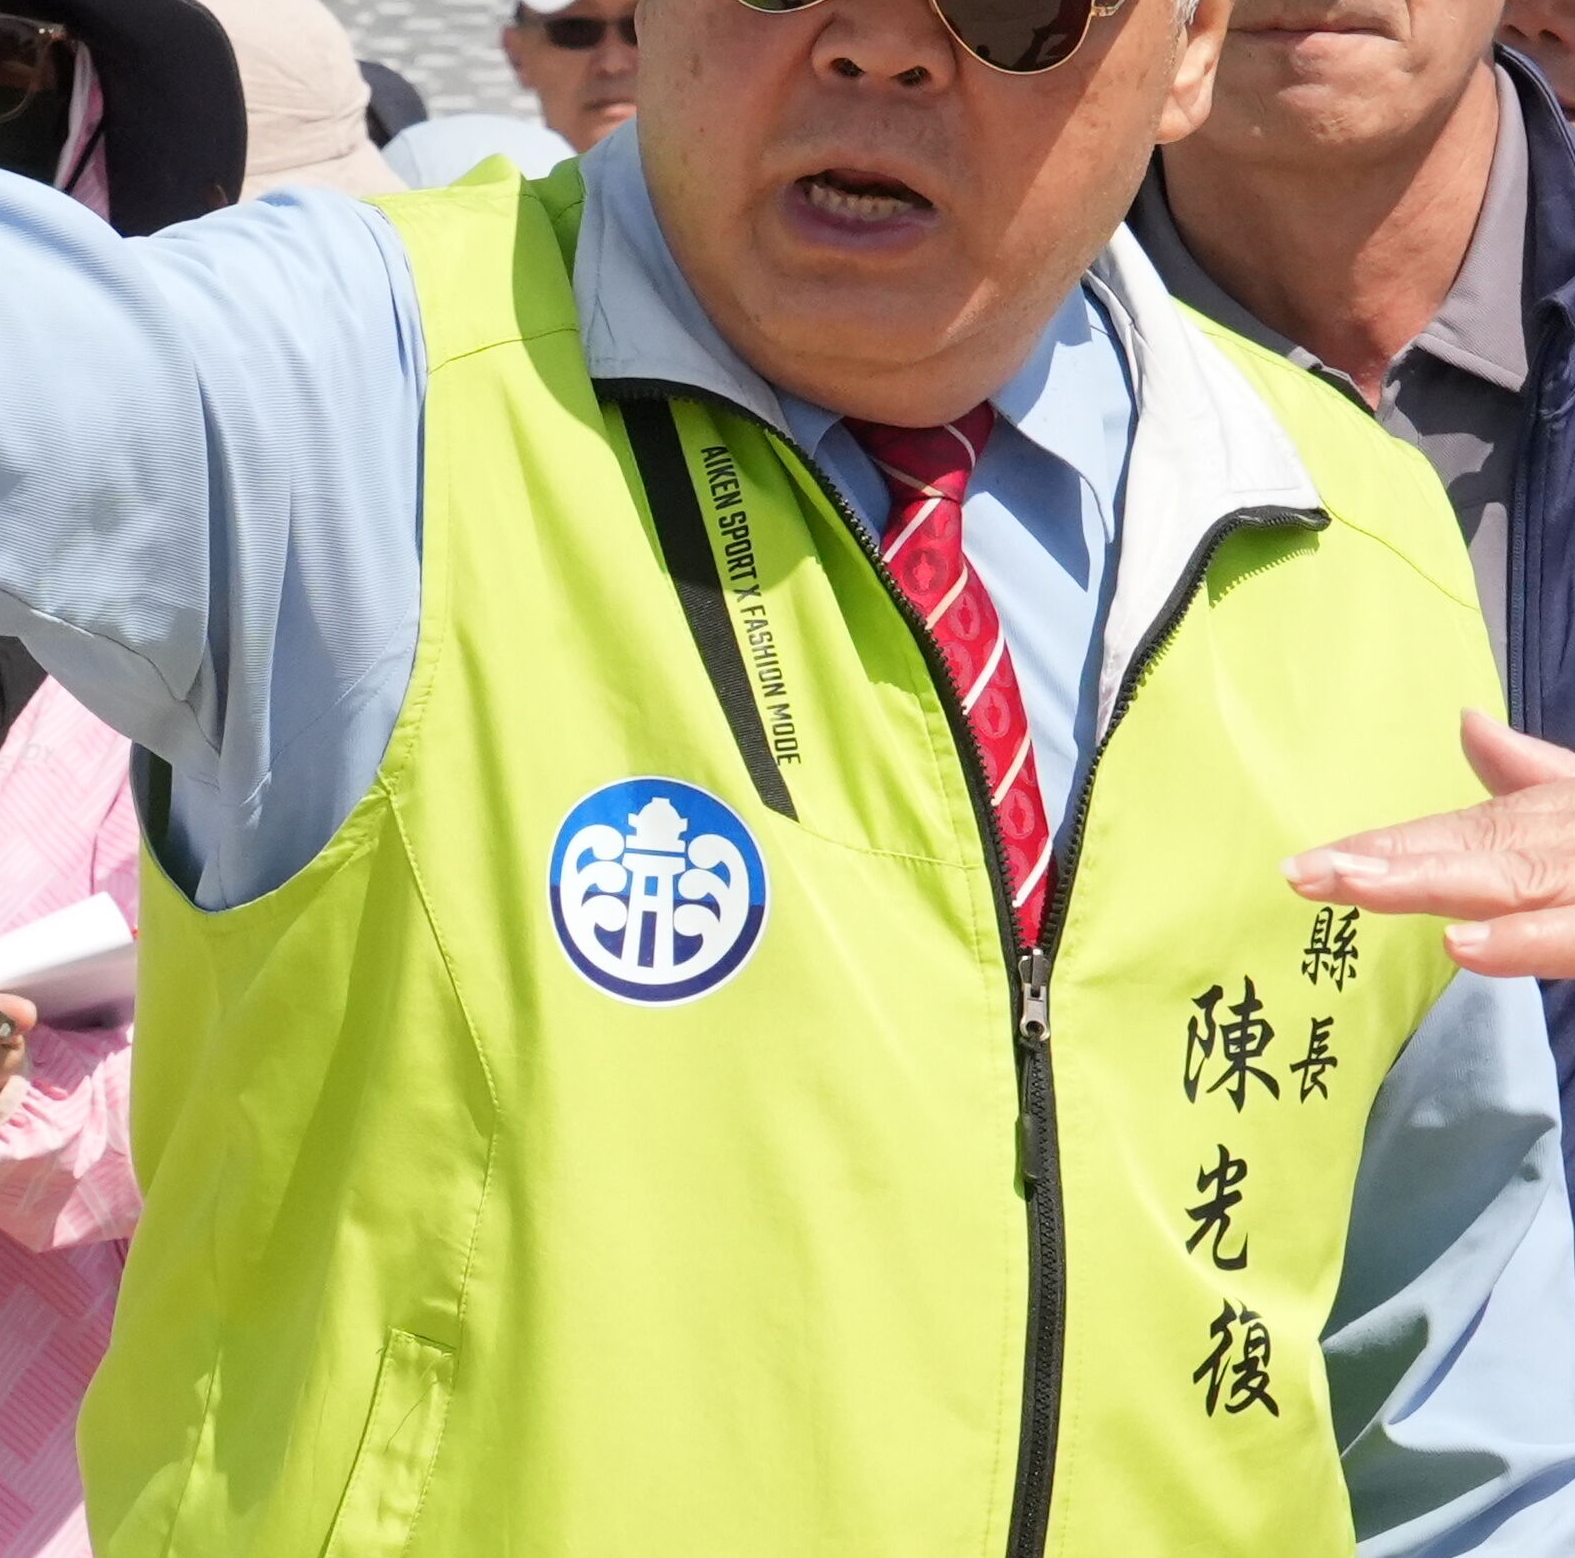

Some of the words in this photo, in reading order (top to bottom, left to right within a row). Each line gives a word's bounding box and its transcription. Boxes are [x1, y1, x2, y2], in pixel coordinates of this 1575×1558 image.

[701, 445, 743, 511] AIKEN
[718, 509, 758, 582] SPORT
[733, 582, 762, 604] X
[740, 604, 787, 698] FASHION
[767, 701, 801, 766] MODE
[1289, 905, 1360, 1103] 縣長
[1183, 973, 1281, 1418] 陳光復
